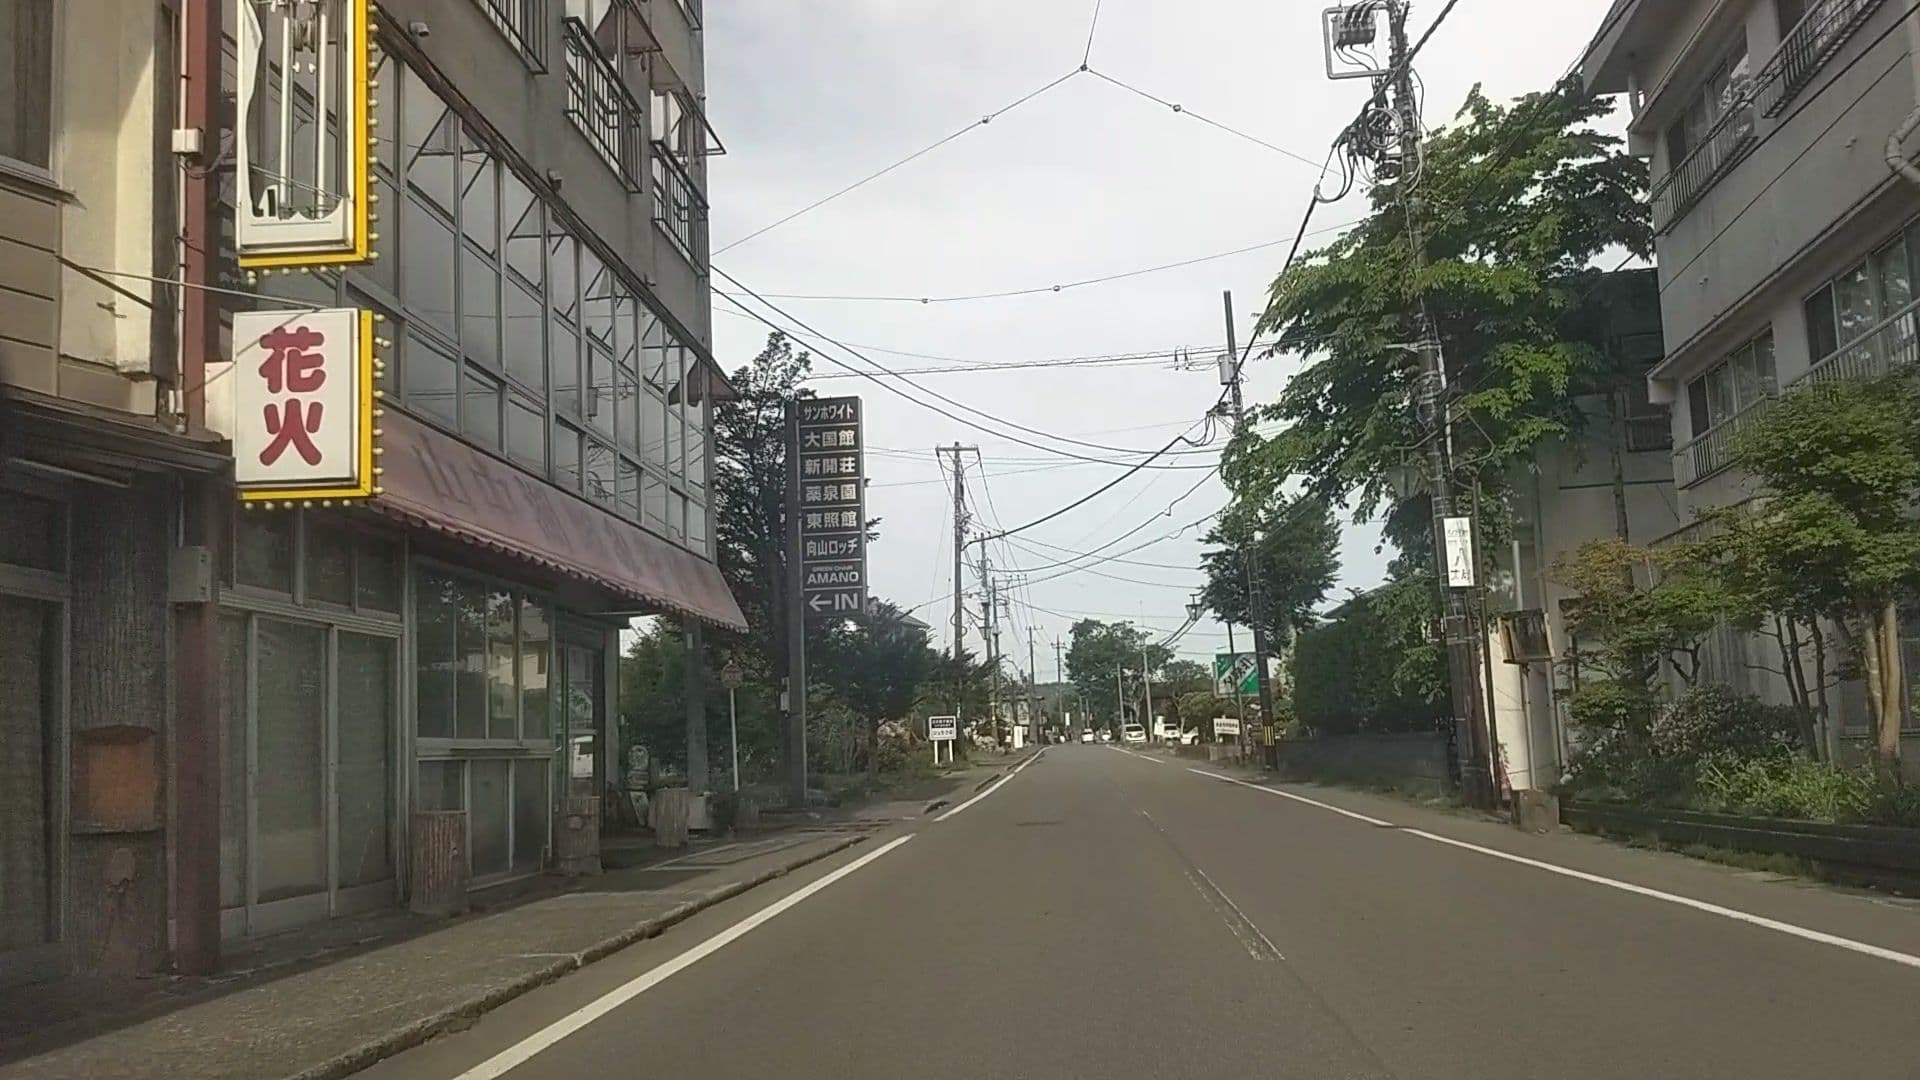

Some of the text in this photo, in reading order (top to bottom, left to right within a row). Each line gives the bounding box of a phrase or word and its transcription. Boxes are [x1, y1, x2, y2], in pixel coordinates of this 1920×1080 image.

[259, 326, 326, 466] 花火
[804, 430, 855, 448] 大国館
[806, 511, 857, 529] 東照館
[807, 571, 859, 585] AMANO
[834, 593, 858, 611] IN
